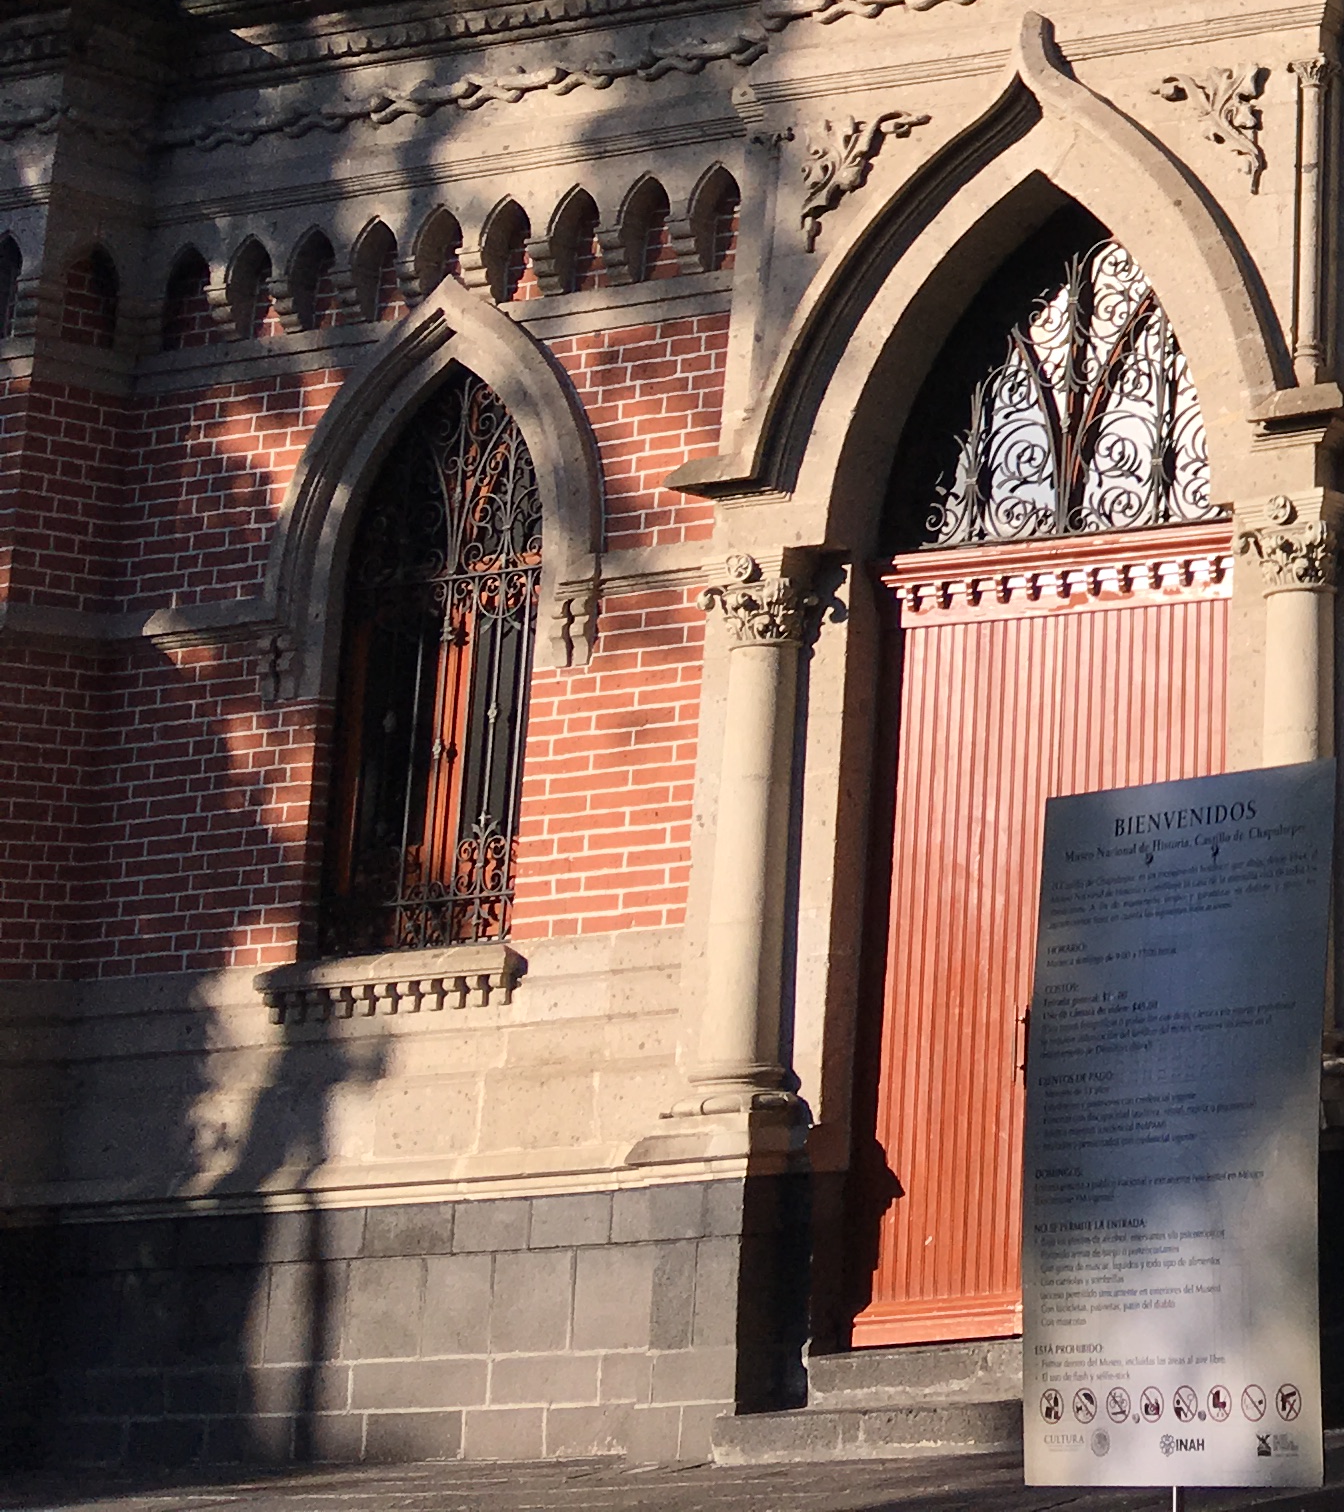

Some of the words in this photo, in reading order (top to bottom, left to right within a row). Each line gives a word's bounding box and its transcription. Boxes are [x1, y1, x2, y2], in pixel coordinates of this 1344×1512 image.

[1114, 799, 1258, 837] BIENVENIDOS
[1043, 1434, 1085, 1444] CULTURA
[1175, 1438, 1206, 1452] INAH
